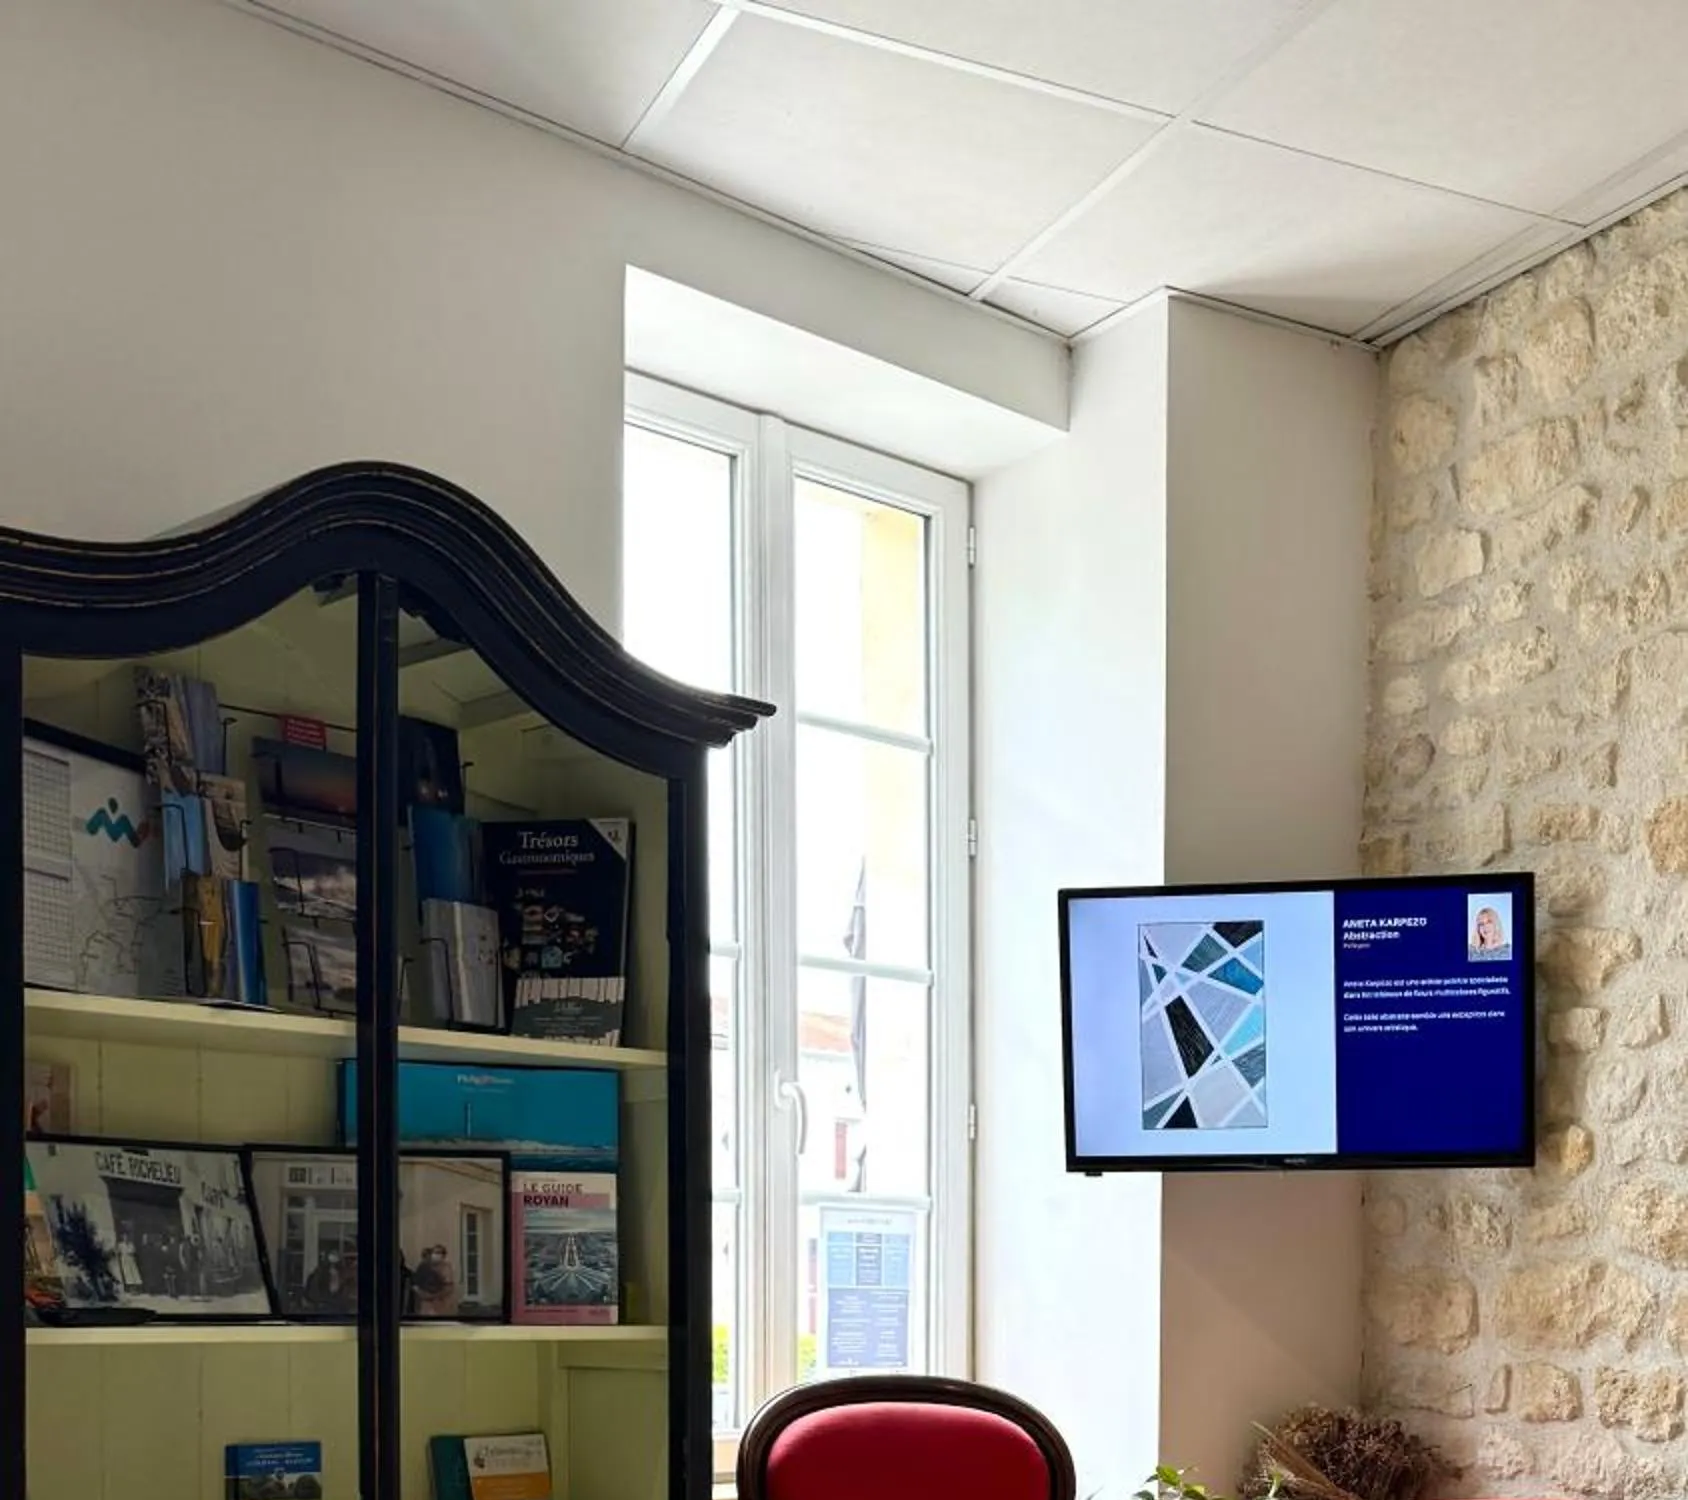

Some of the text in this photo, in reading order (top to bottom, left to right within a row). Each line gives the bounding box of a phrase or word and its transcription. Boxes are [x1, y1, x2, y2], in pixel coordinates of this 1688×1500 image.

[1342, 919, 1377, 928] ANETA
[542, 1183, 583, 1194] GUIDE
[523, 1194, 569, 1208] ROYAN
